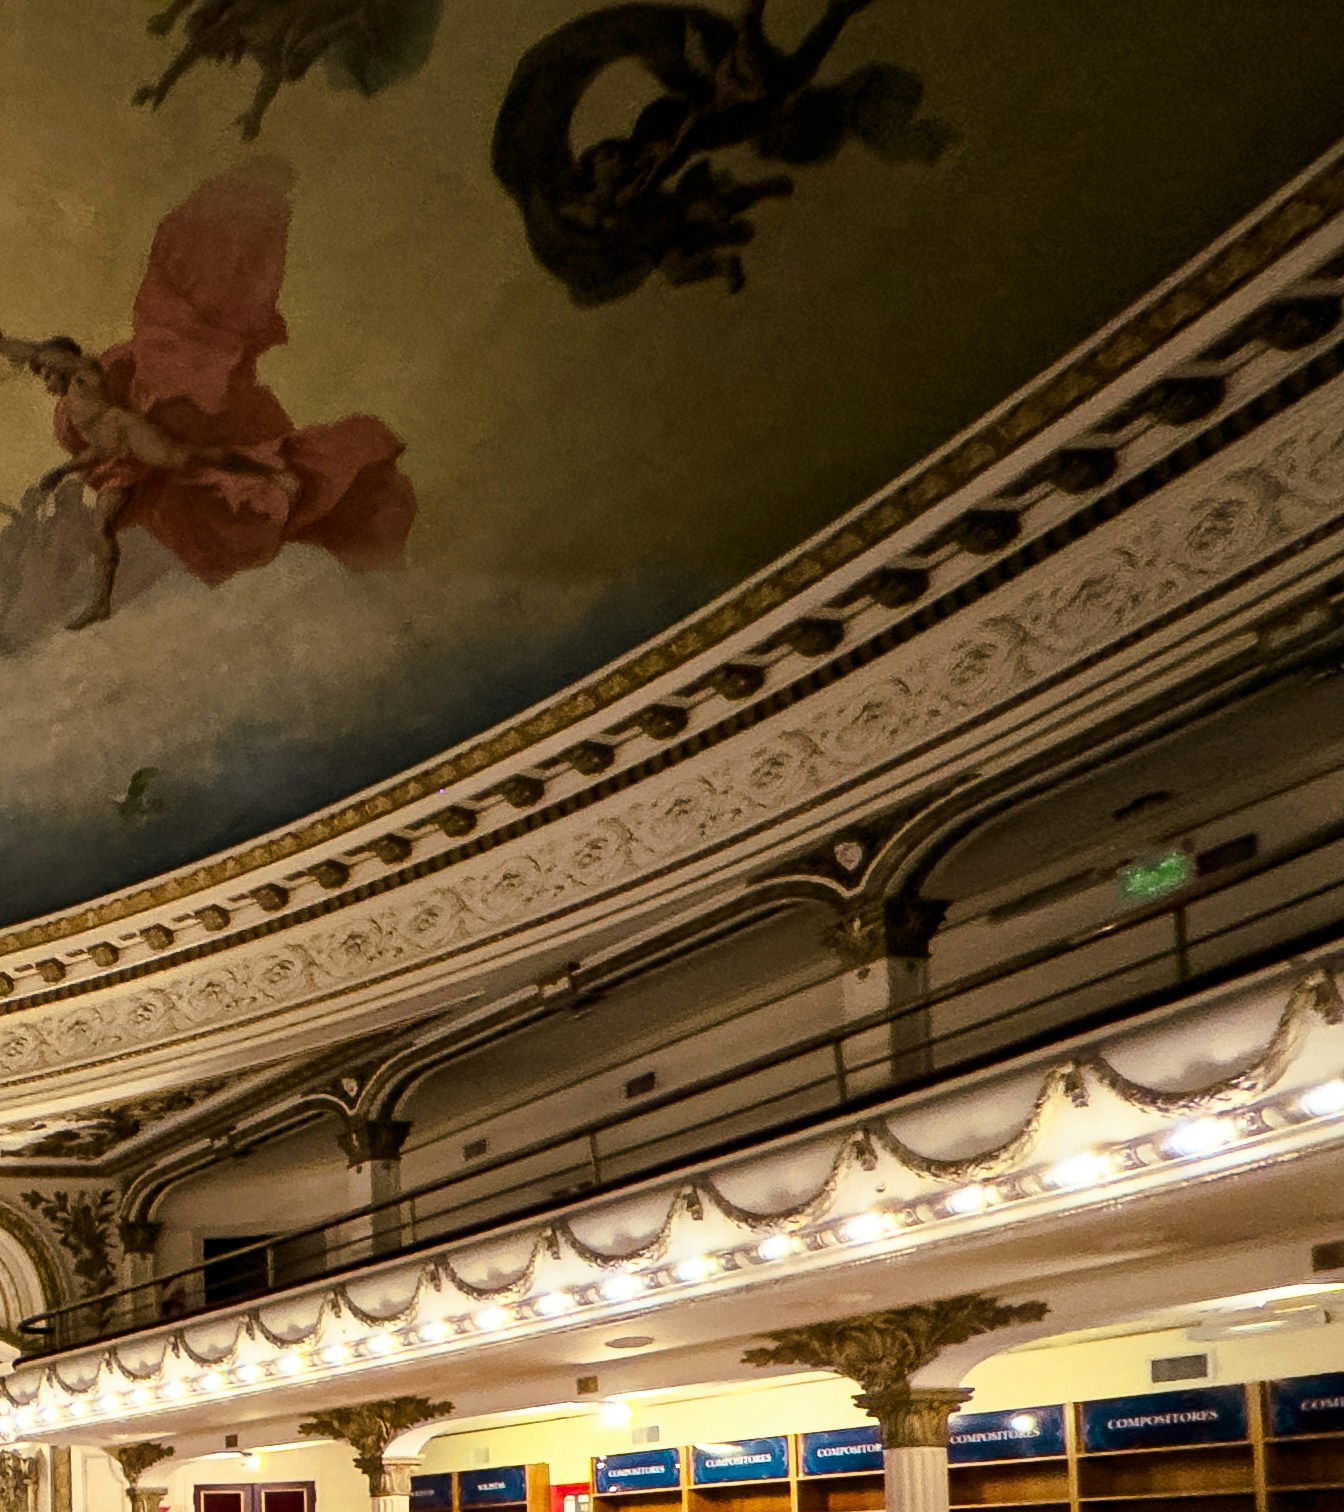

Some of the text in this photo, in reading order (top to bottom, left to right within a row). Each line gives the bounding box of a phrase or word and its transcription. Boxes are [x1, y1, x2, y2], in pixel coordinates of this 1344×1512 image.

[1107, 1409, 1219, 1431] COMPOSITORES
[950, 1428, 1040, 1445] COMPOSITORES
[704, 1453, 773, 1469] COMPOSITORES
